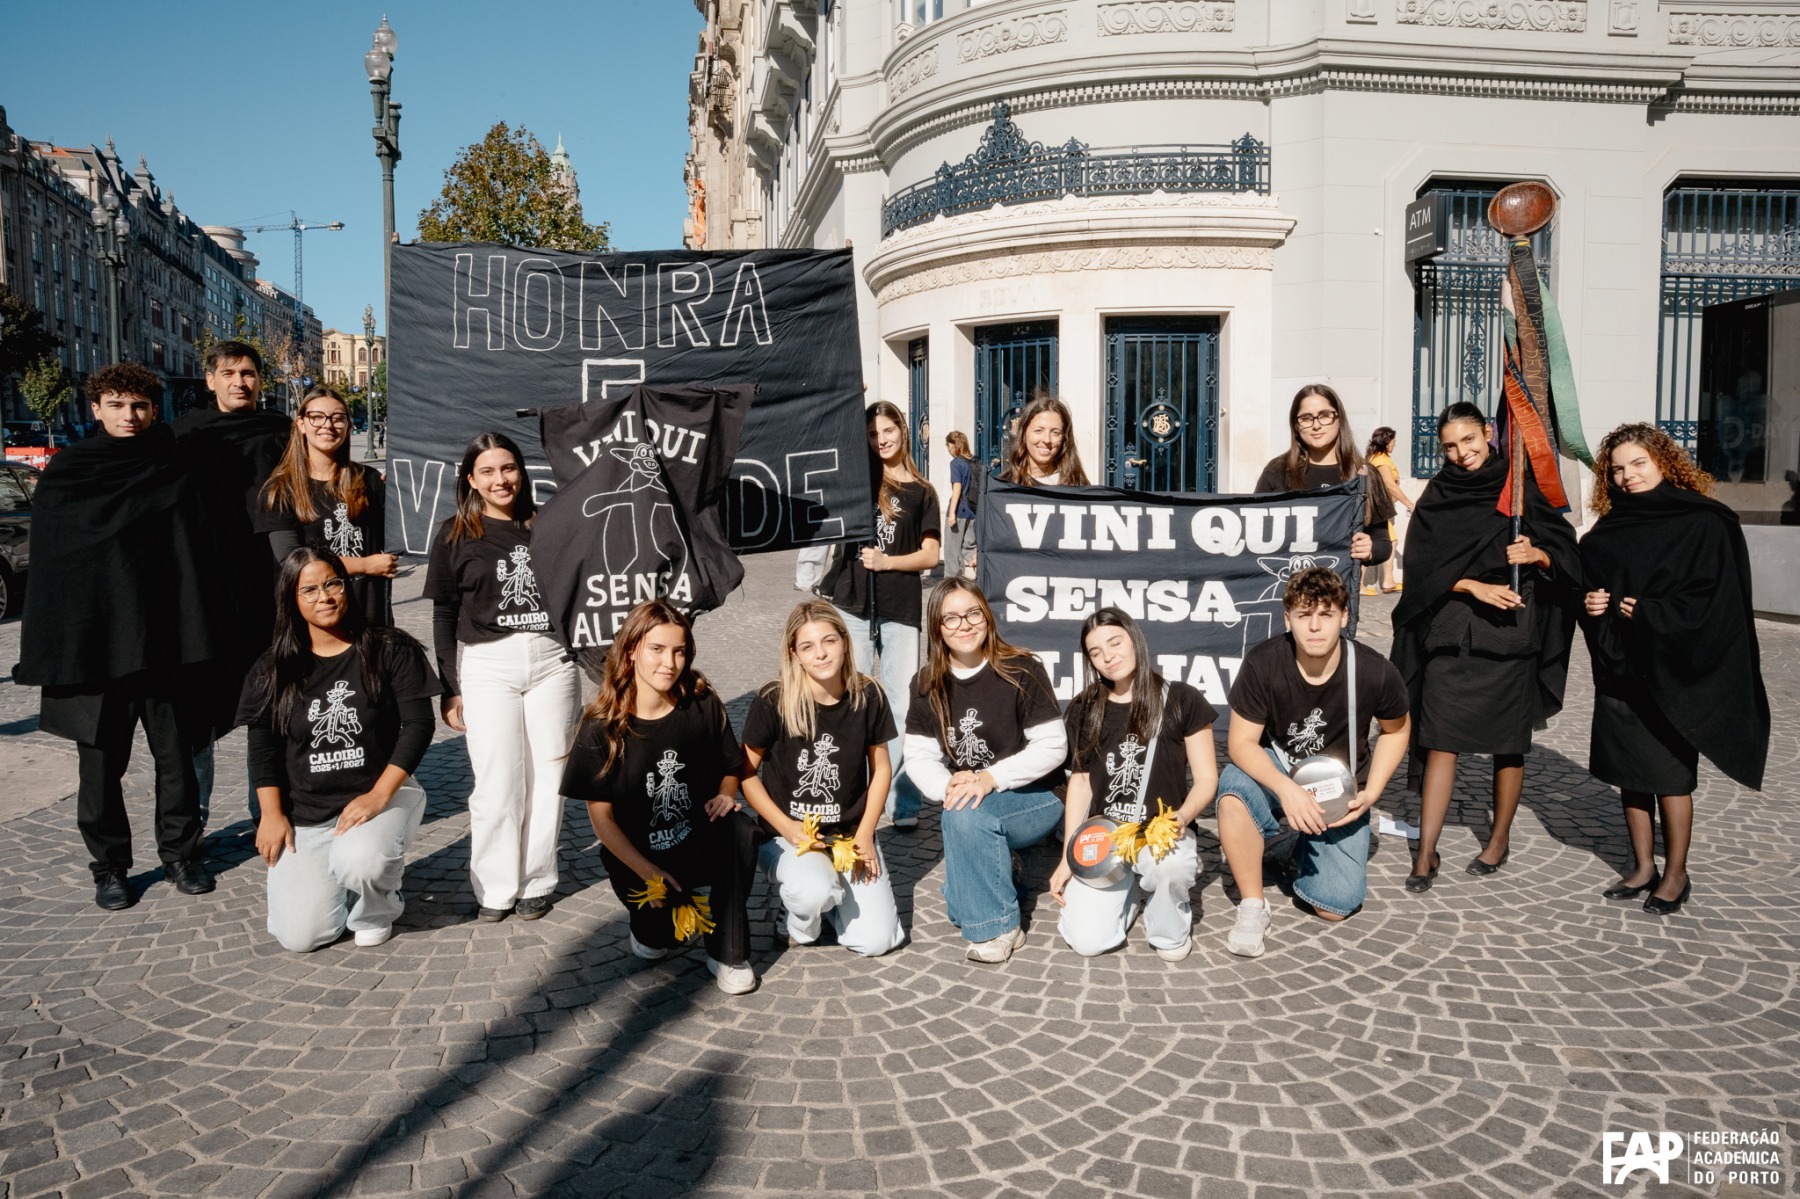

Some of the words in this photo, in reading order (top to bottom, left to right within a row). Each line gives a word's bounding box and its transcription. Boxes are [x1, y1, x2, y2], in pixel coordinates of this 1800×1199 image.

[1409, 206, 1431, 231] ATM
[453, 253, 773, 351] HONRA
[1005, 503, 1176, 551] VINI
[1191, 506, 1319, 557] QUI
[585, 572, 693, 607] SENSA
[1005, 576, 1242, 623] SENSA
[497, 612, 549, 626] CALOIRO
[309, 747, 365, 765] CALOIRO
[310, 758, 365, 773] 2025+1/2027
[790, 801, 841, 816] CALOIRO
